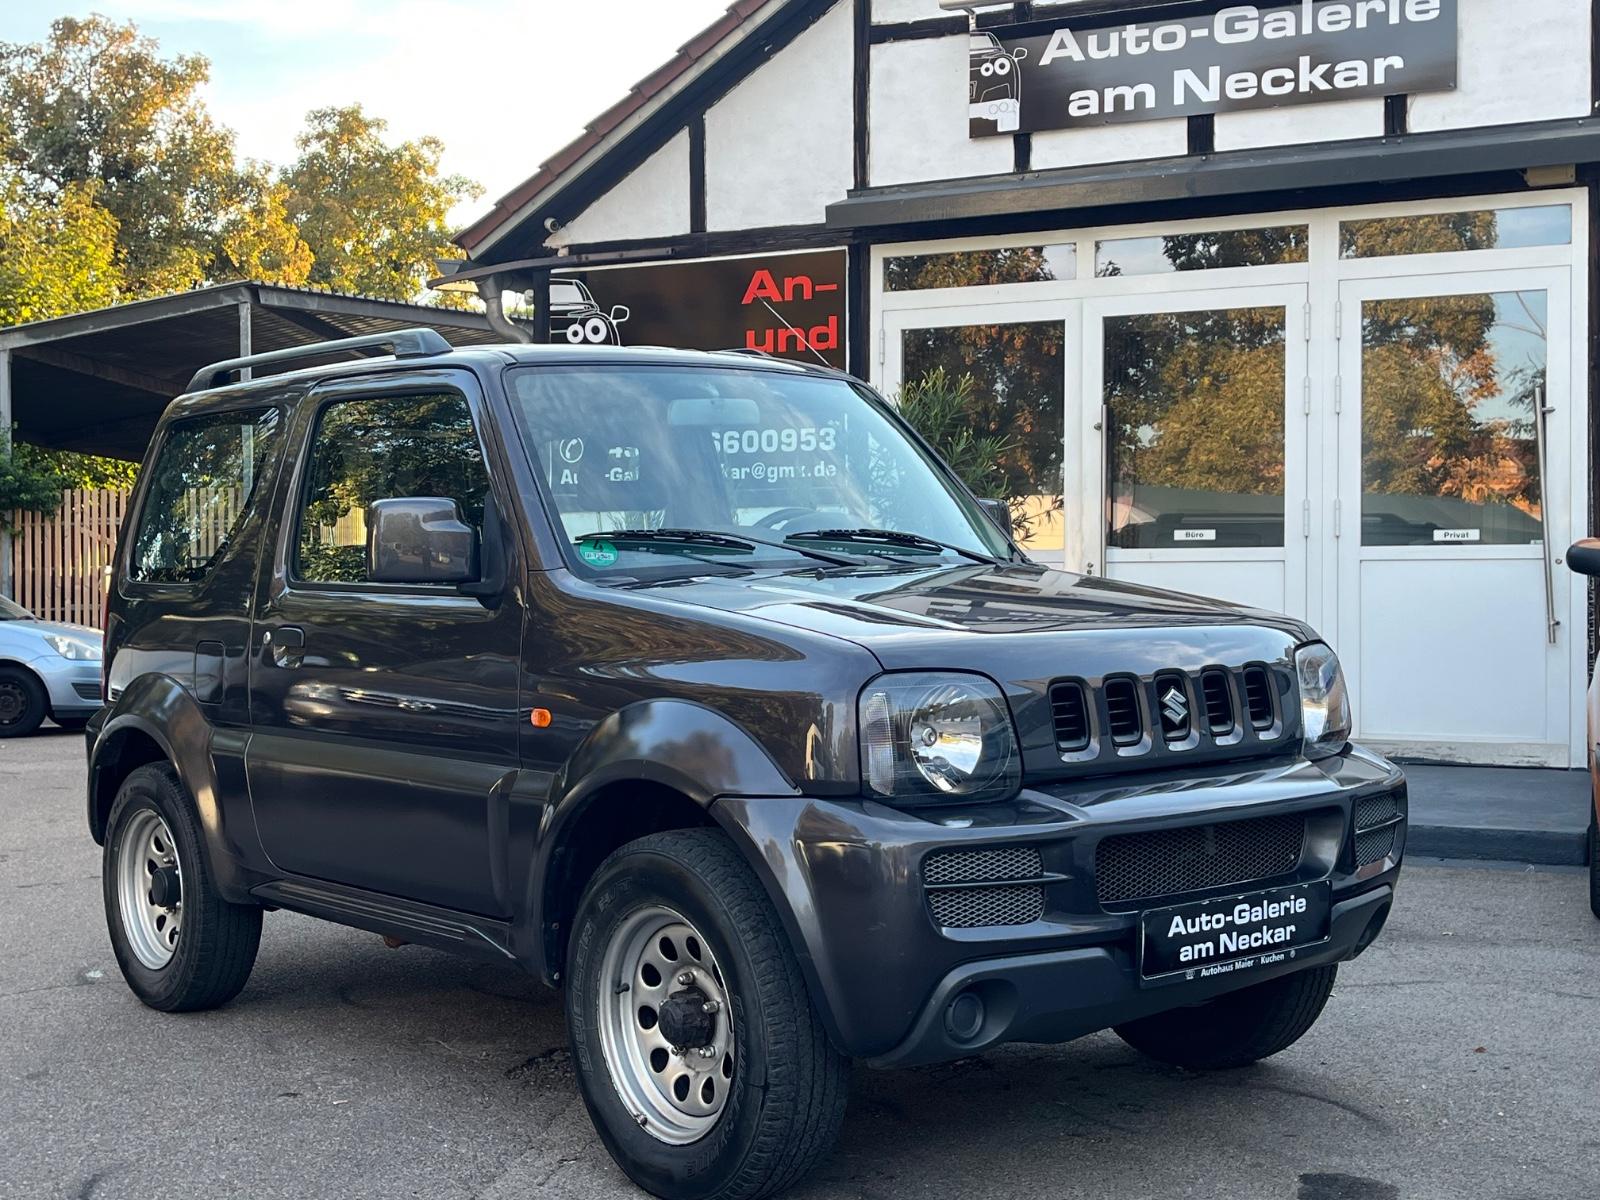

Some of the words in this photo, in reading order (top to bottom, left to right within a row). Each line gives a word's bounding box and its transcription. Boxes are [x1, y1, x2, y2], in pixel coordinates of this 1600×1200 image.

[1038, 0, 1440, 66] Auto-Galerie
[1067, 82, 1156, 118] am
[1173, 55, 1404, 106] Neckar
[741, 269, 838, 305] An-
[745, 315, 838, 352] und
[1167, 895, 1307, 937] Auto-Galerie
[1179, 942, 1215, 962] am
[1219, 924, 1296, 955] Neckar
[1200, 964, 1234, 977] Autohaus
[1234, 958, 1254, 970] Maier
